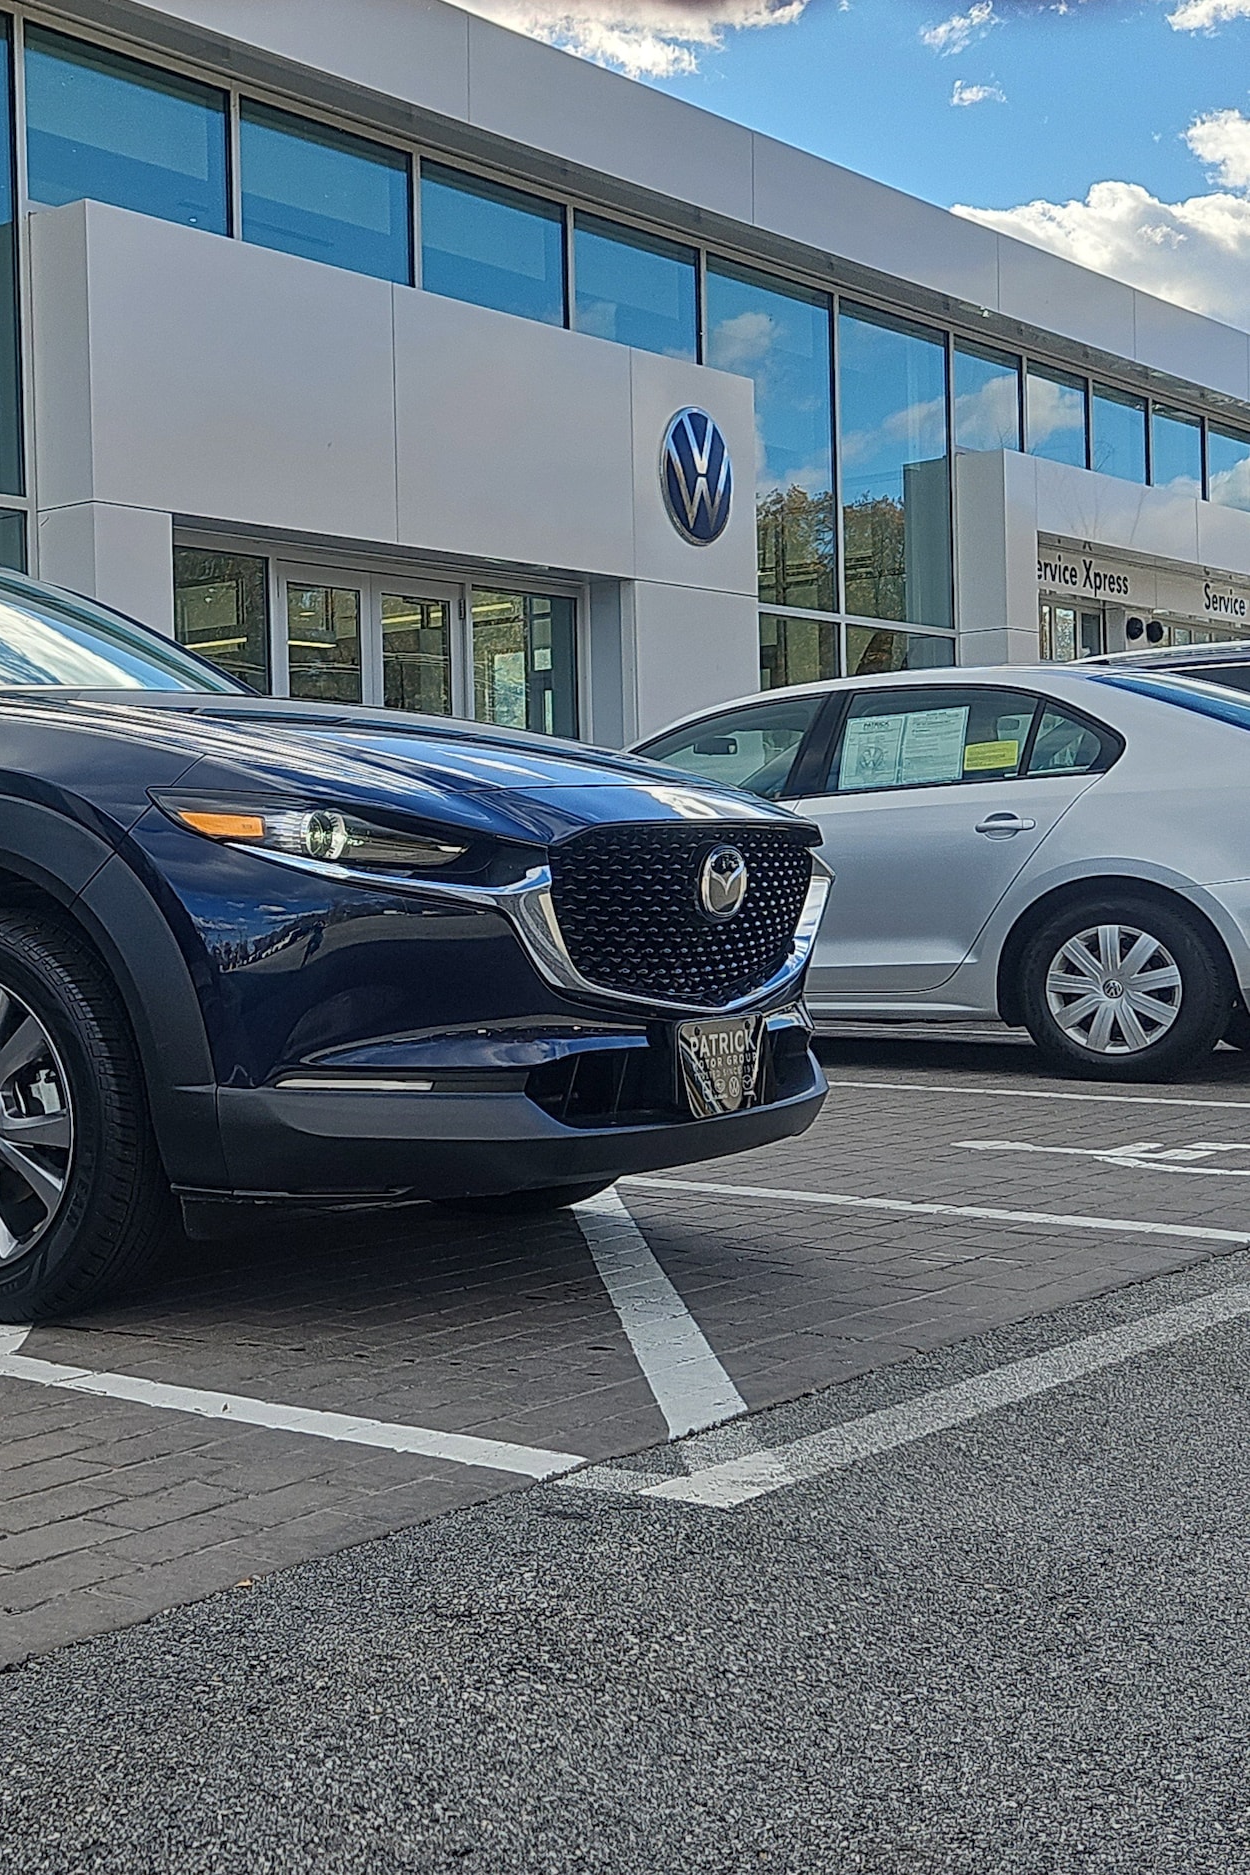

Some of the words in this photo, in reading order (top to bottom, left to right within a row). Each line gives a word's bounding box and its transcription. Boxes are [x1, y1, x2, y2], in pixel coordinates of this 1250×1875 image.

[1037, 555, 1078, 585] ervice
[1082, 559, 1129, 597] Xpress
[1204, 583, 1246, 616] Service
[690, 1028, 756, 1058] PATRICK
[726, 1052, 758, 1066] GROUP
